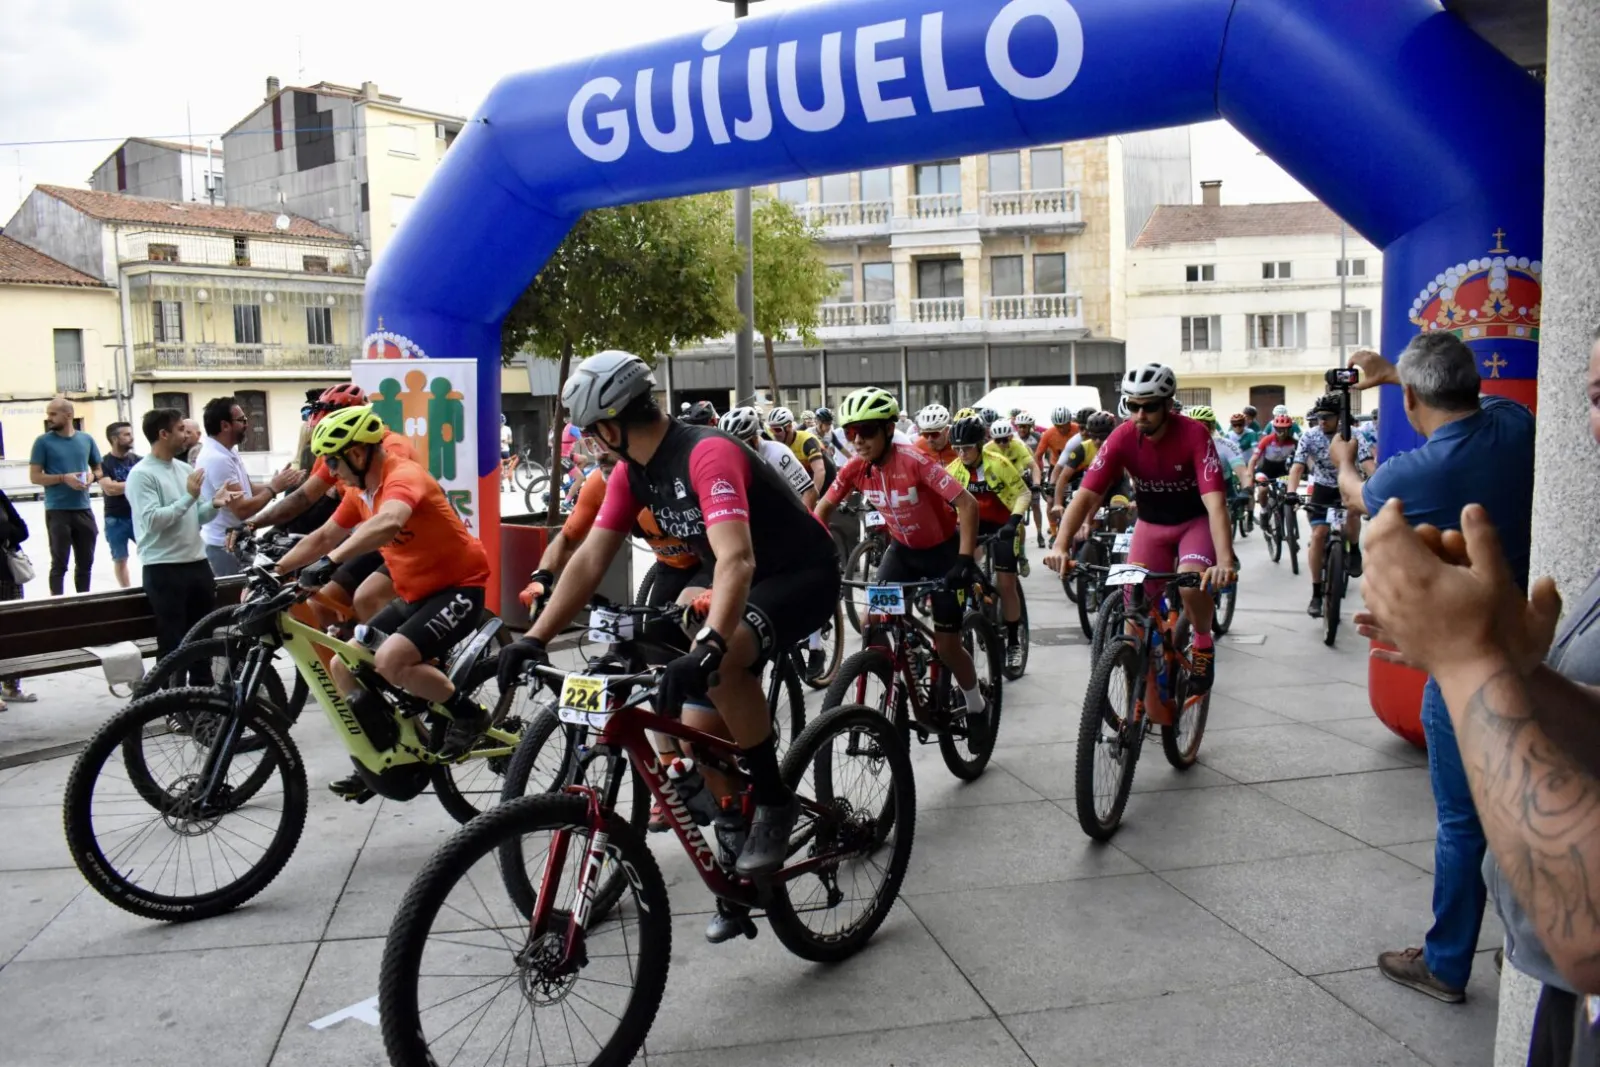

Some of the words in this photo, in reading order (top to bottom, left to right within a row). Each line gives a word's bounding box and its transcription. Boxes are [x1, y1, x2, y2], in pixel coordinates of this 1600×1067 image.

[424, 593, 473, 640] INEOS
[871, 594, 899, 606] 409
[308, 660, 362, 735] SPECIALIZED
[564, 687, 600, 710] 224
[643, 757, 715, 872] S-WORKS
